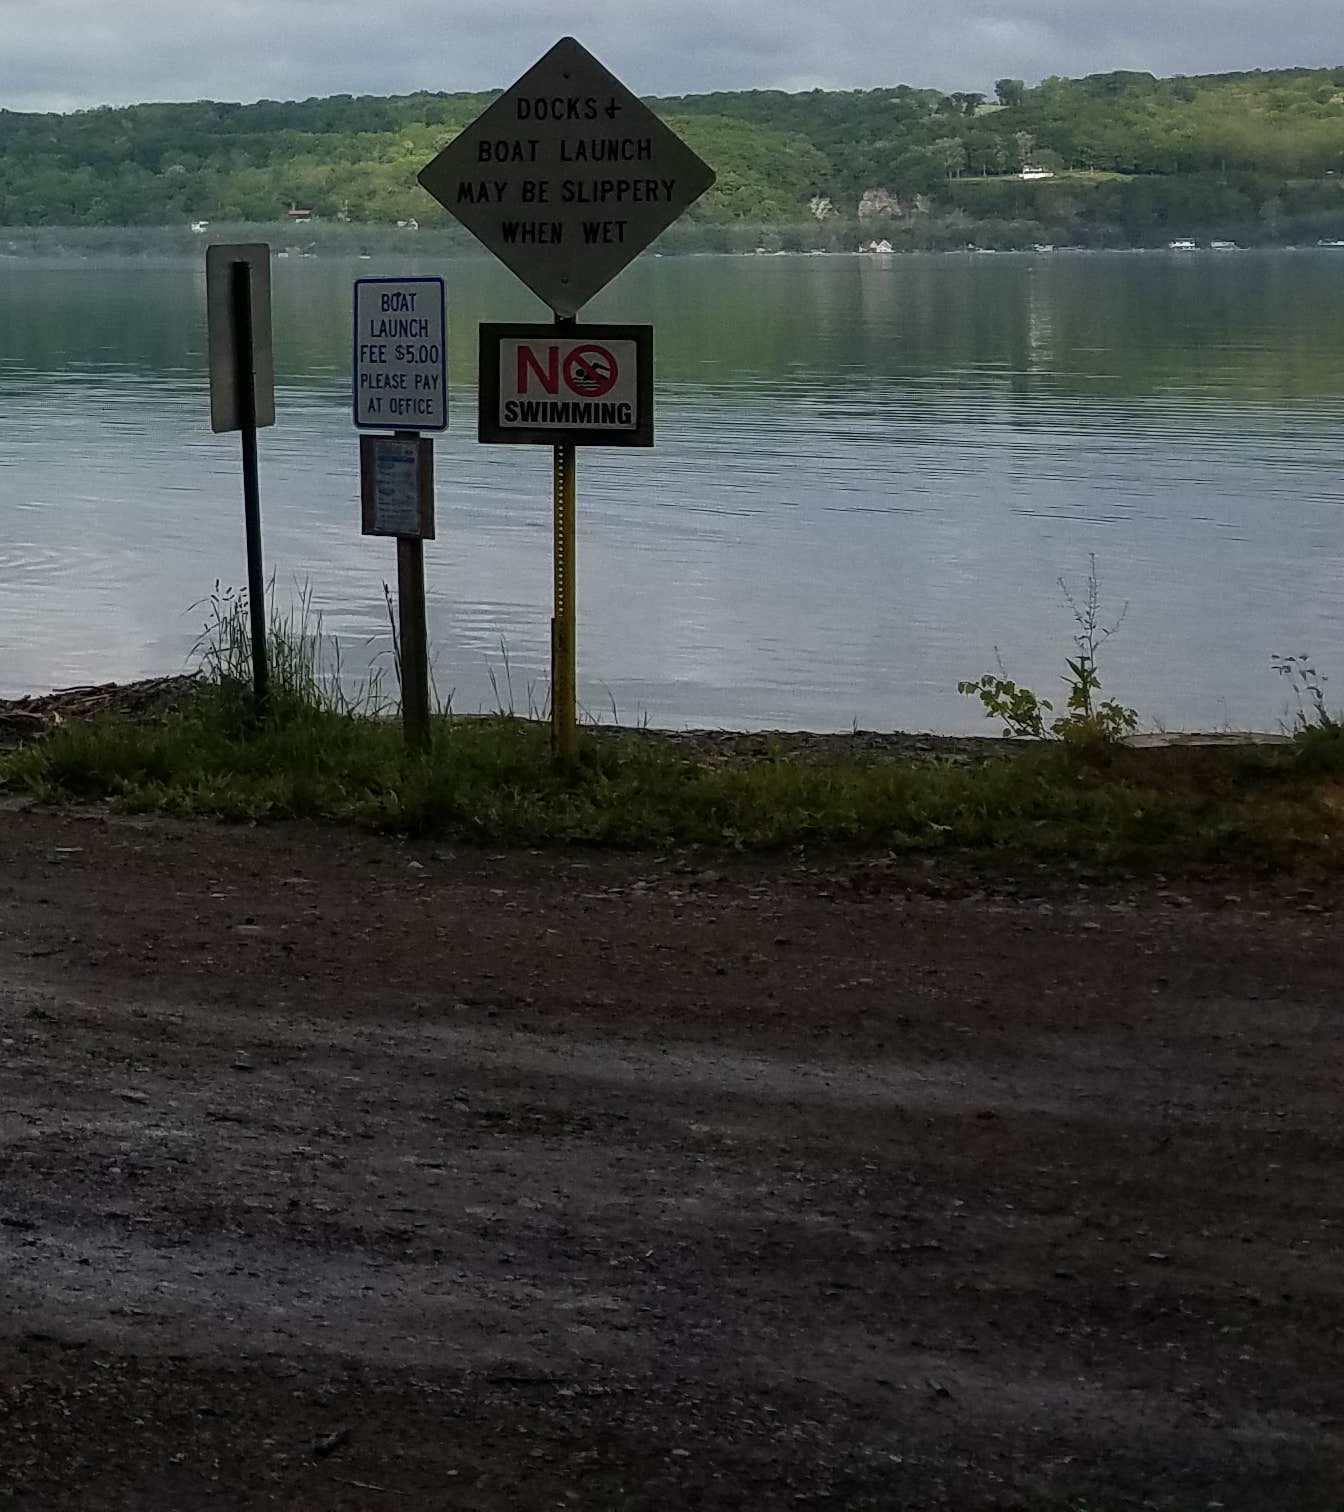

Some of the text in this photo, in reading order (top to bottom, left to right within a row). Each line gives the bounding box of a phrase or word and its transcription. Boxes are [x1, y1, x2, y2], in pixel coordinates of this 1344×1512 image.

[517, 97, 598, 120] DOCKS
[477, 138, 652, 163] BOAT LAUNCH
[457, 179, 676, 204] MAY BE SLIPPERY
[501, 220, 628, 244] WHEN WET
[381, 292, 417, 312] BOAT
[370, 318, 429, 338] LAUNCH
[360, 344, 439, 364] FEE $5.00
[361, 373, 439, 390] PLEASE PAY
[367, 397, 433, 415] AT OFFICE
[504, 400, 632, 425] SWIMMING
